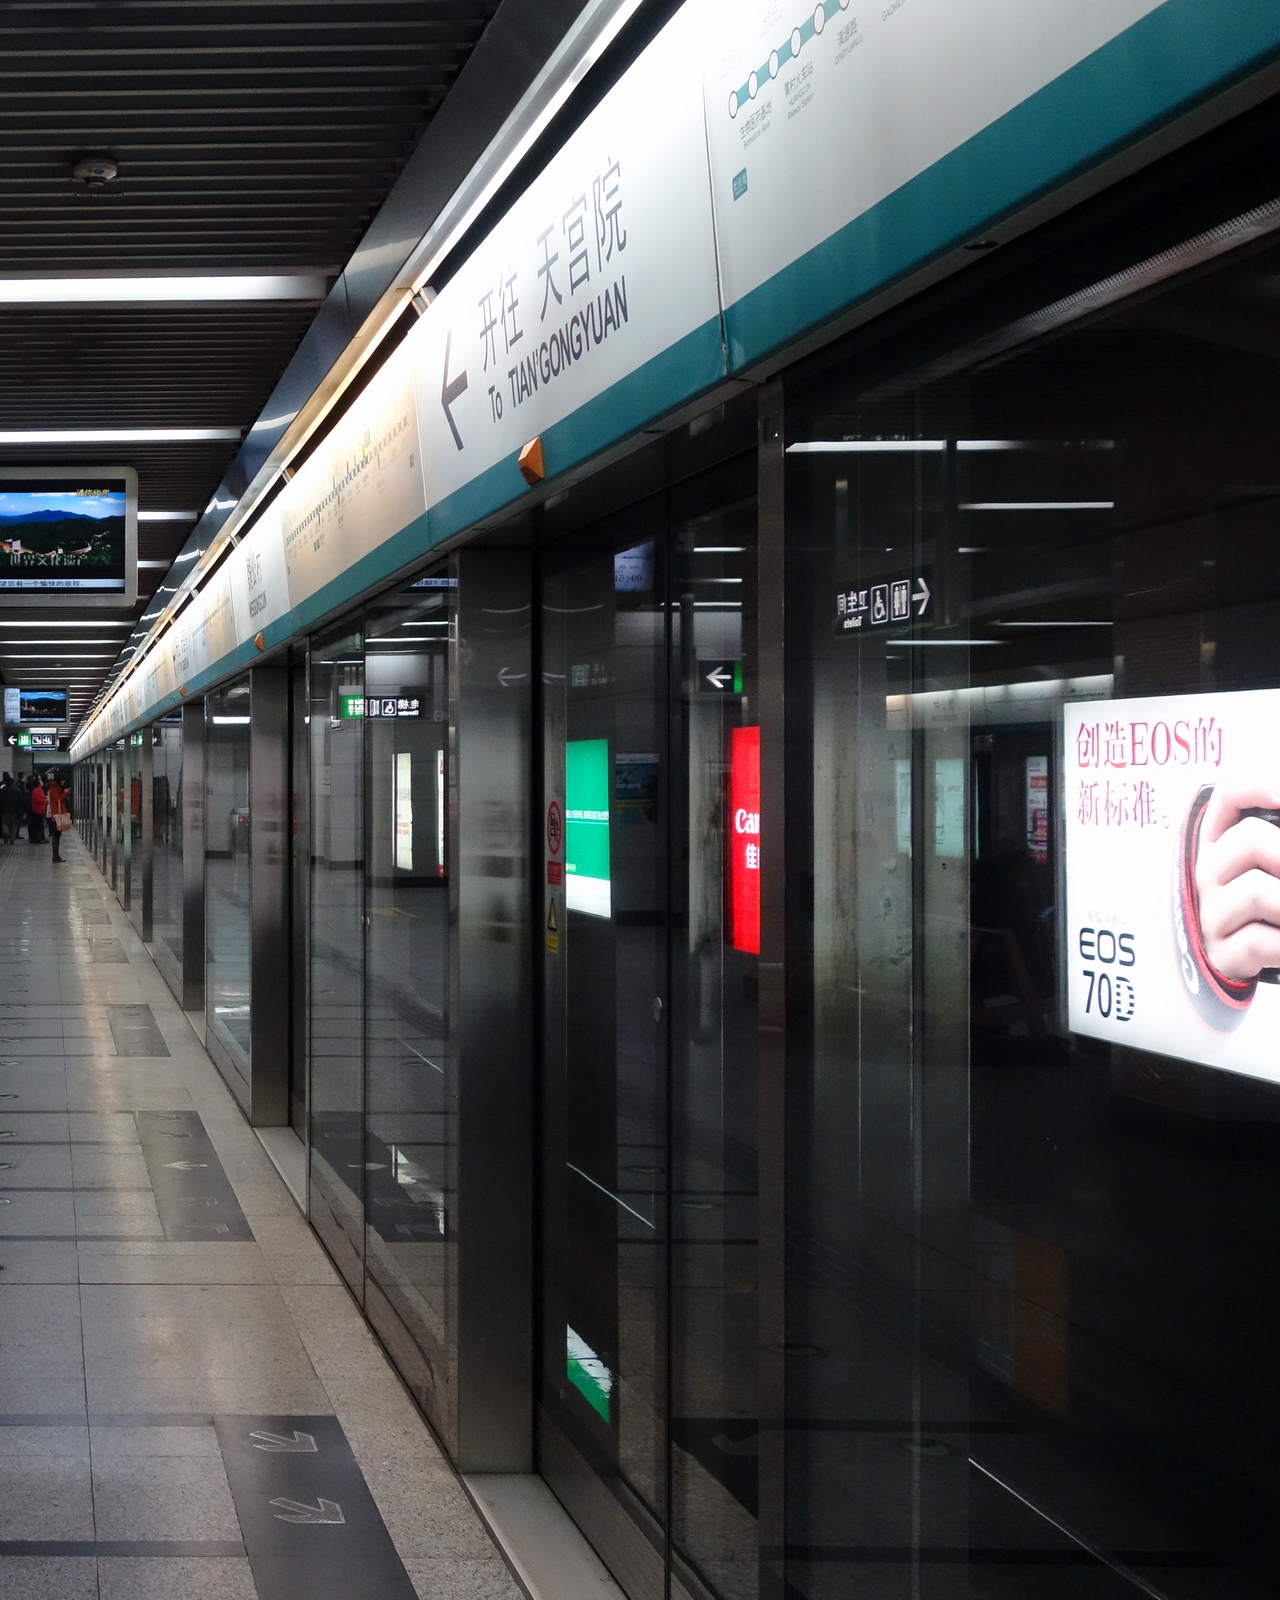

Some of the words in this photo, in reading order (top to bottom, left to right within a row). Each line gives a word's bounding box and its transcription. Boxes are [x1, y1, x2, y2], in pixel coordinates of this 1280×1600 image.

[478, 263, 524, 373] 开往
[536, 155, 627, 323] 天宫院
[487, 384, 503, 424] To
[1075, 716, 1223, 768] 创造EOS的
[1078, 925, 1136, 967] EOS
[1082, 969, 1136, 1022] 70D
